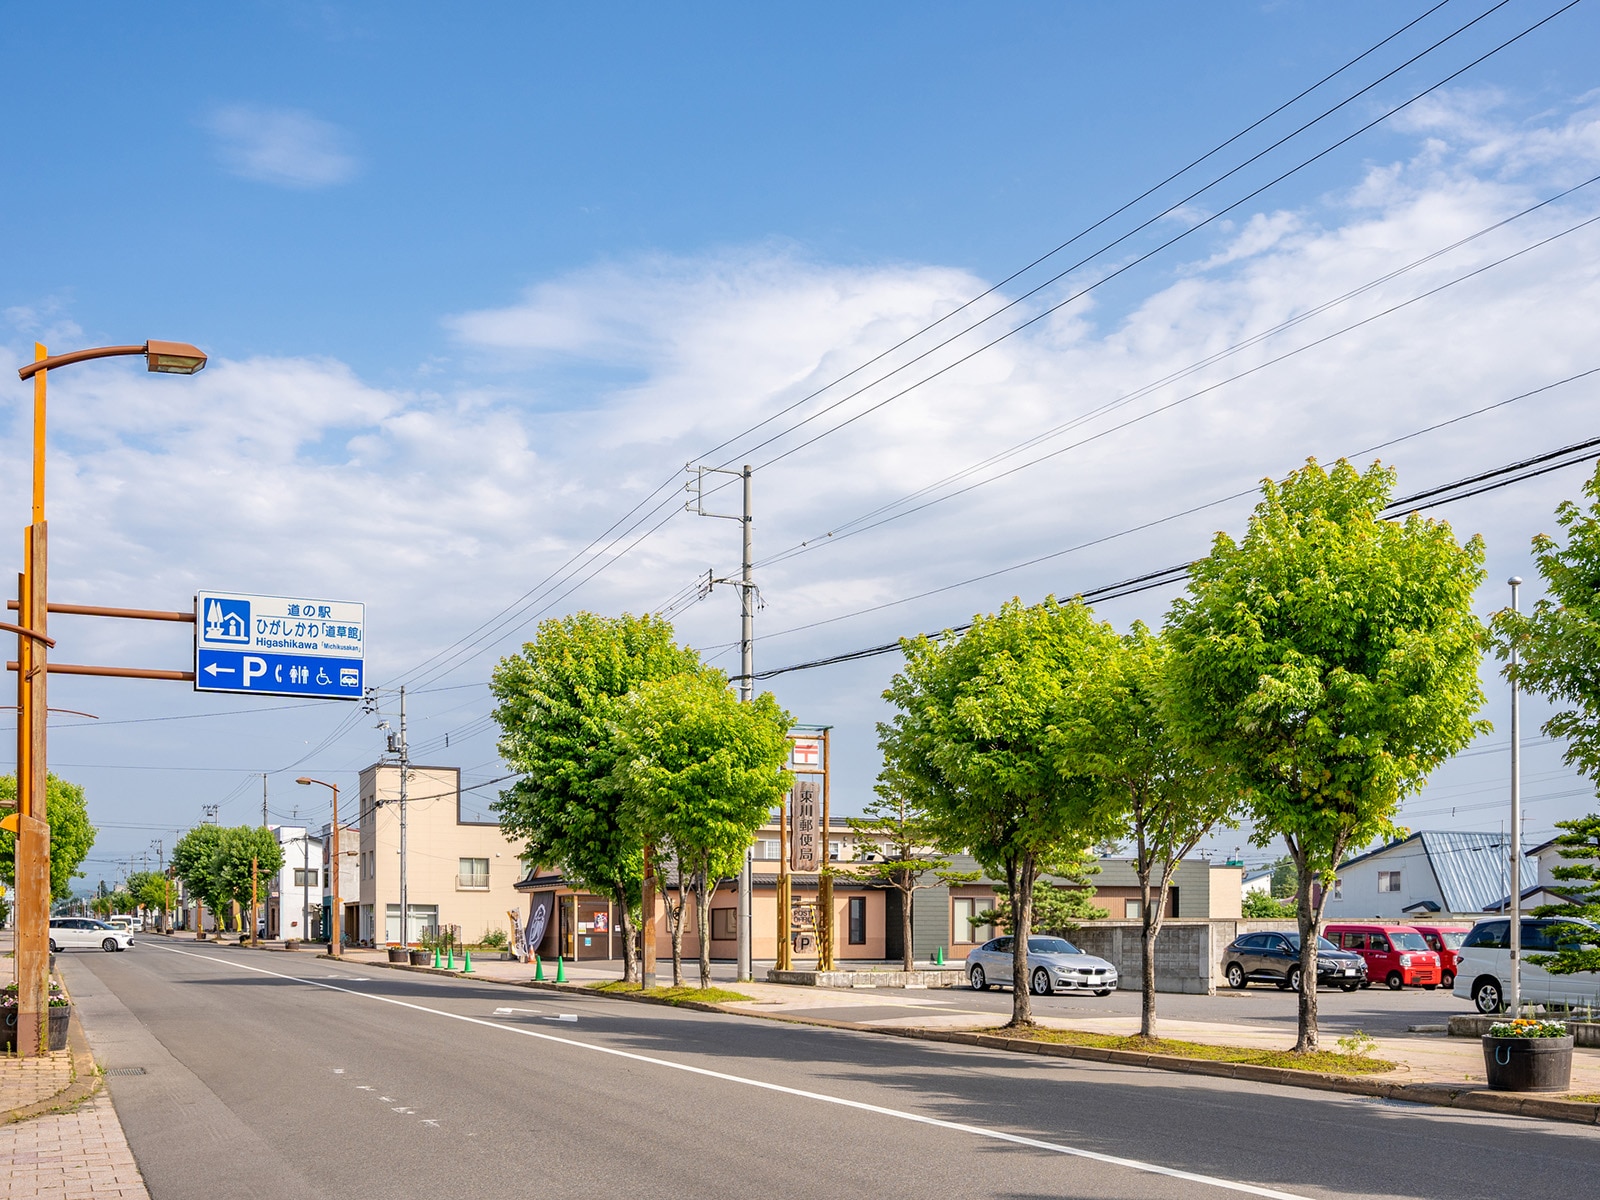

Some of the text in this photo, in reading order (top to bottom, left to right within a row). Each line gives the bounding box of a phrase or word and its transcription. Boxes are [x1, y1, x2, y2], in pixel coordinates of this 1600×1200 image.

[288, 604, 331, 618] 道の駅
[256, 637, 318, 650] Higashikawa
[243, 656, 267, 687] P
[799, 790, 813, 861] 東川郵便局
[801, 938, 810, 950] P
